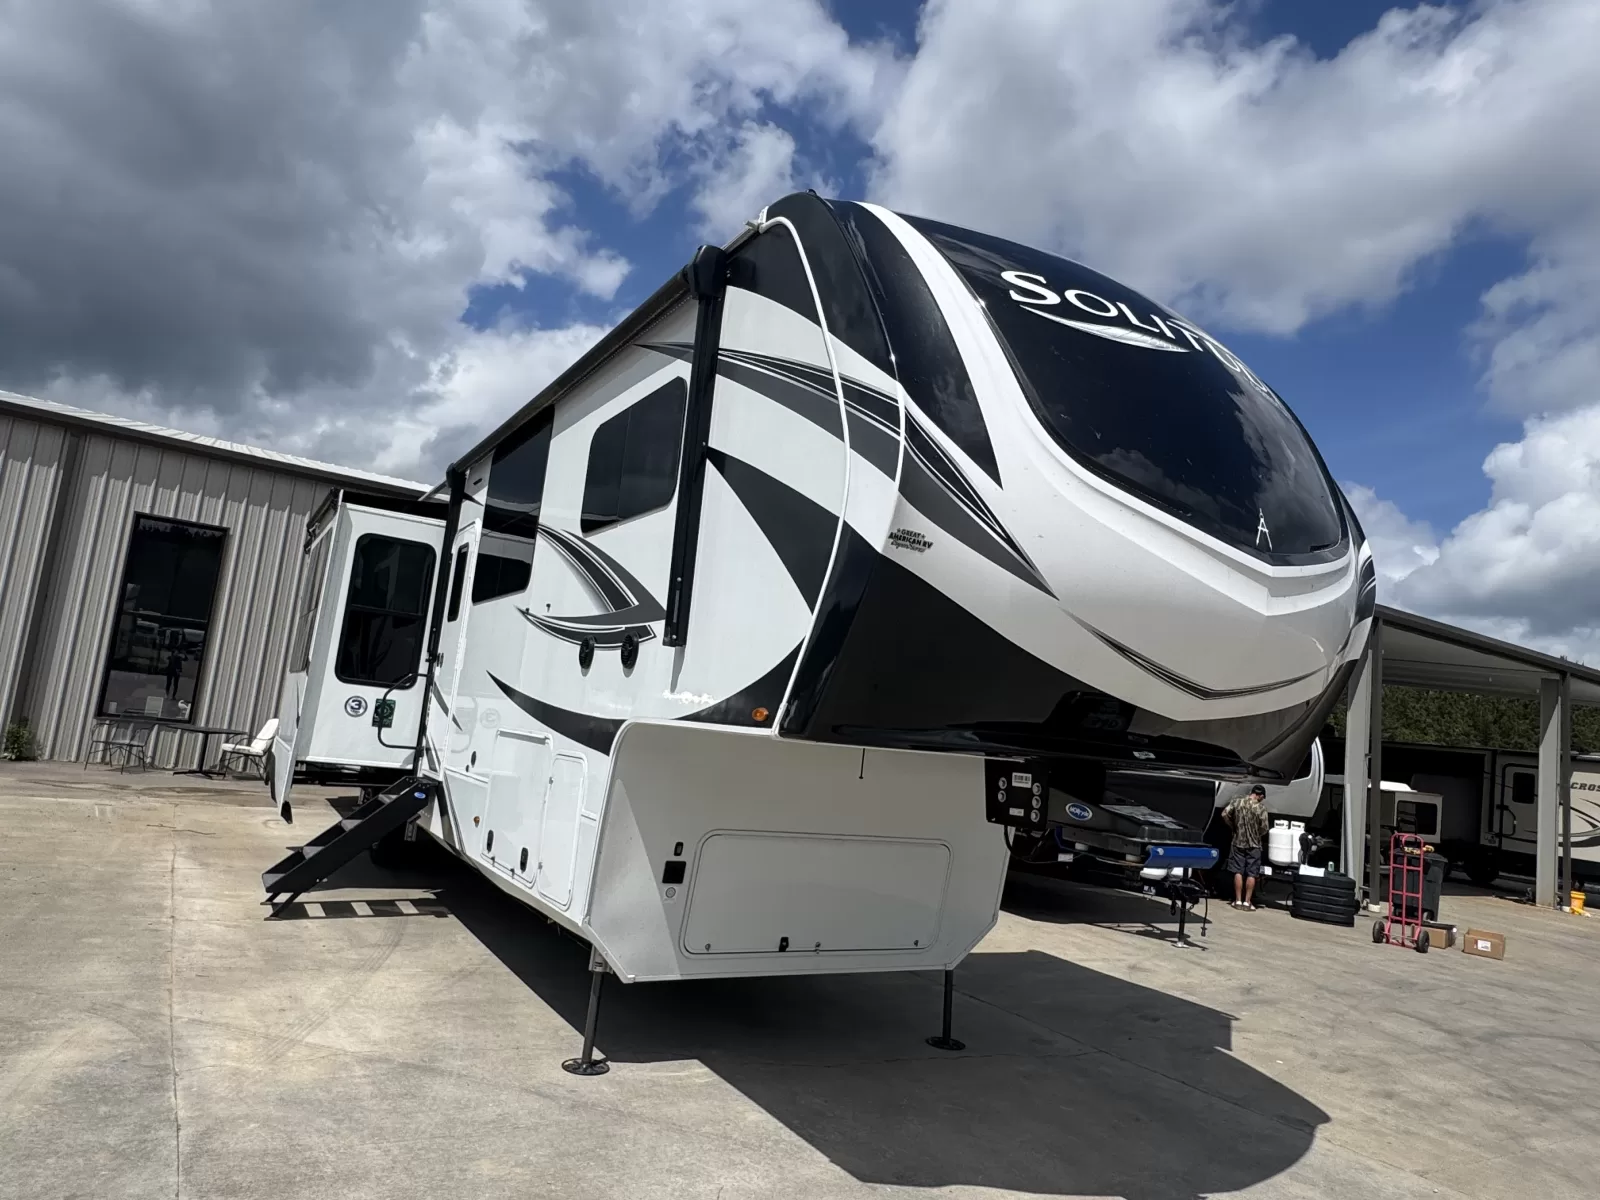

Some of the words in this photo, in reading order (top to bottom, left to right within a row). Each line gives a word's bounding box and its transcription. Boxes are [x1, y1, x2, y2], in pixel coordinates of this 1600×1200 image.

[901, 529, 921, 538] GREAT
[888, 532, 922, 546] AMERICAN
[922, 540, 934, 549] RV
[351, 699, 362, 710] 3
